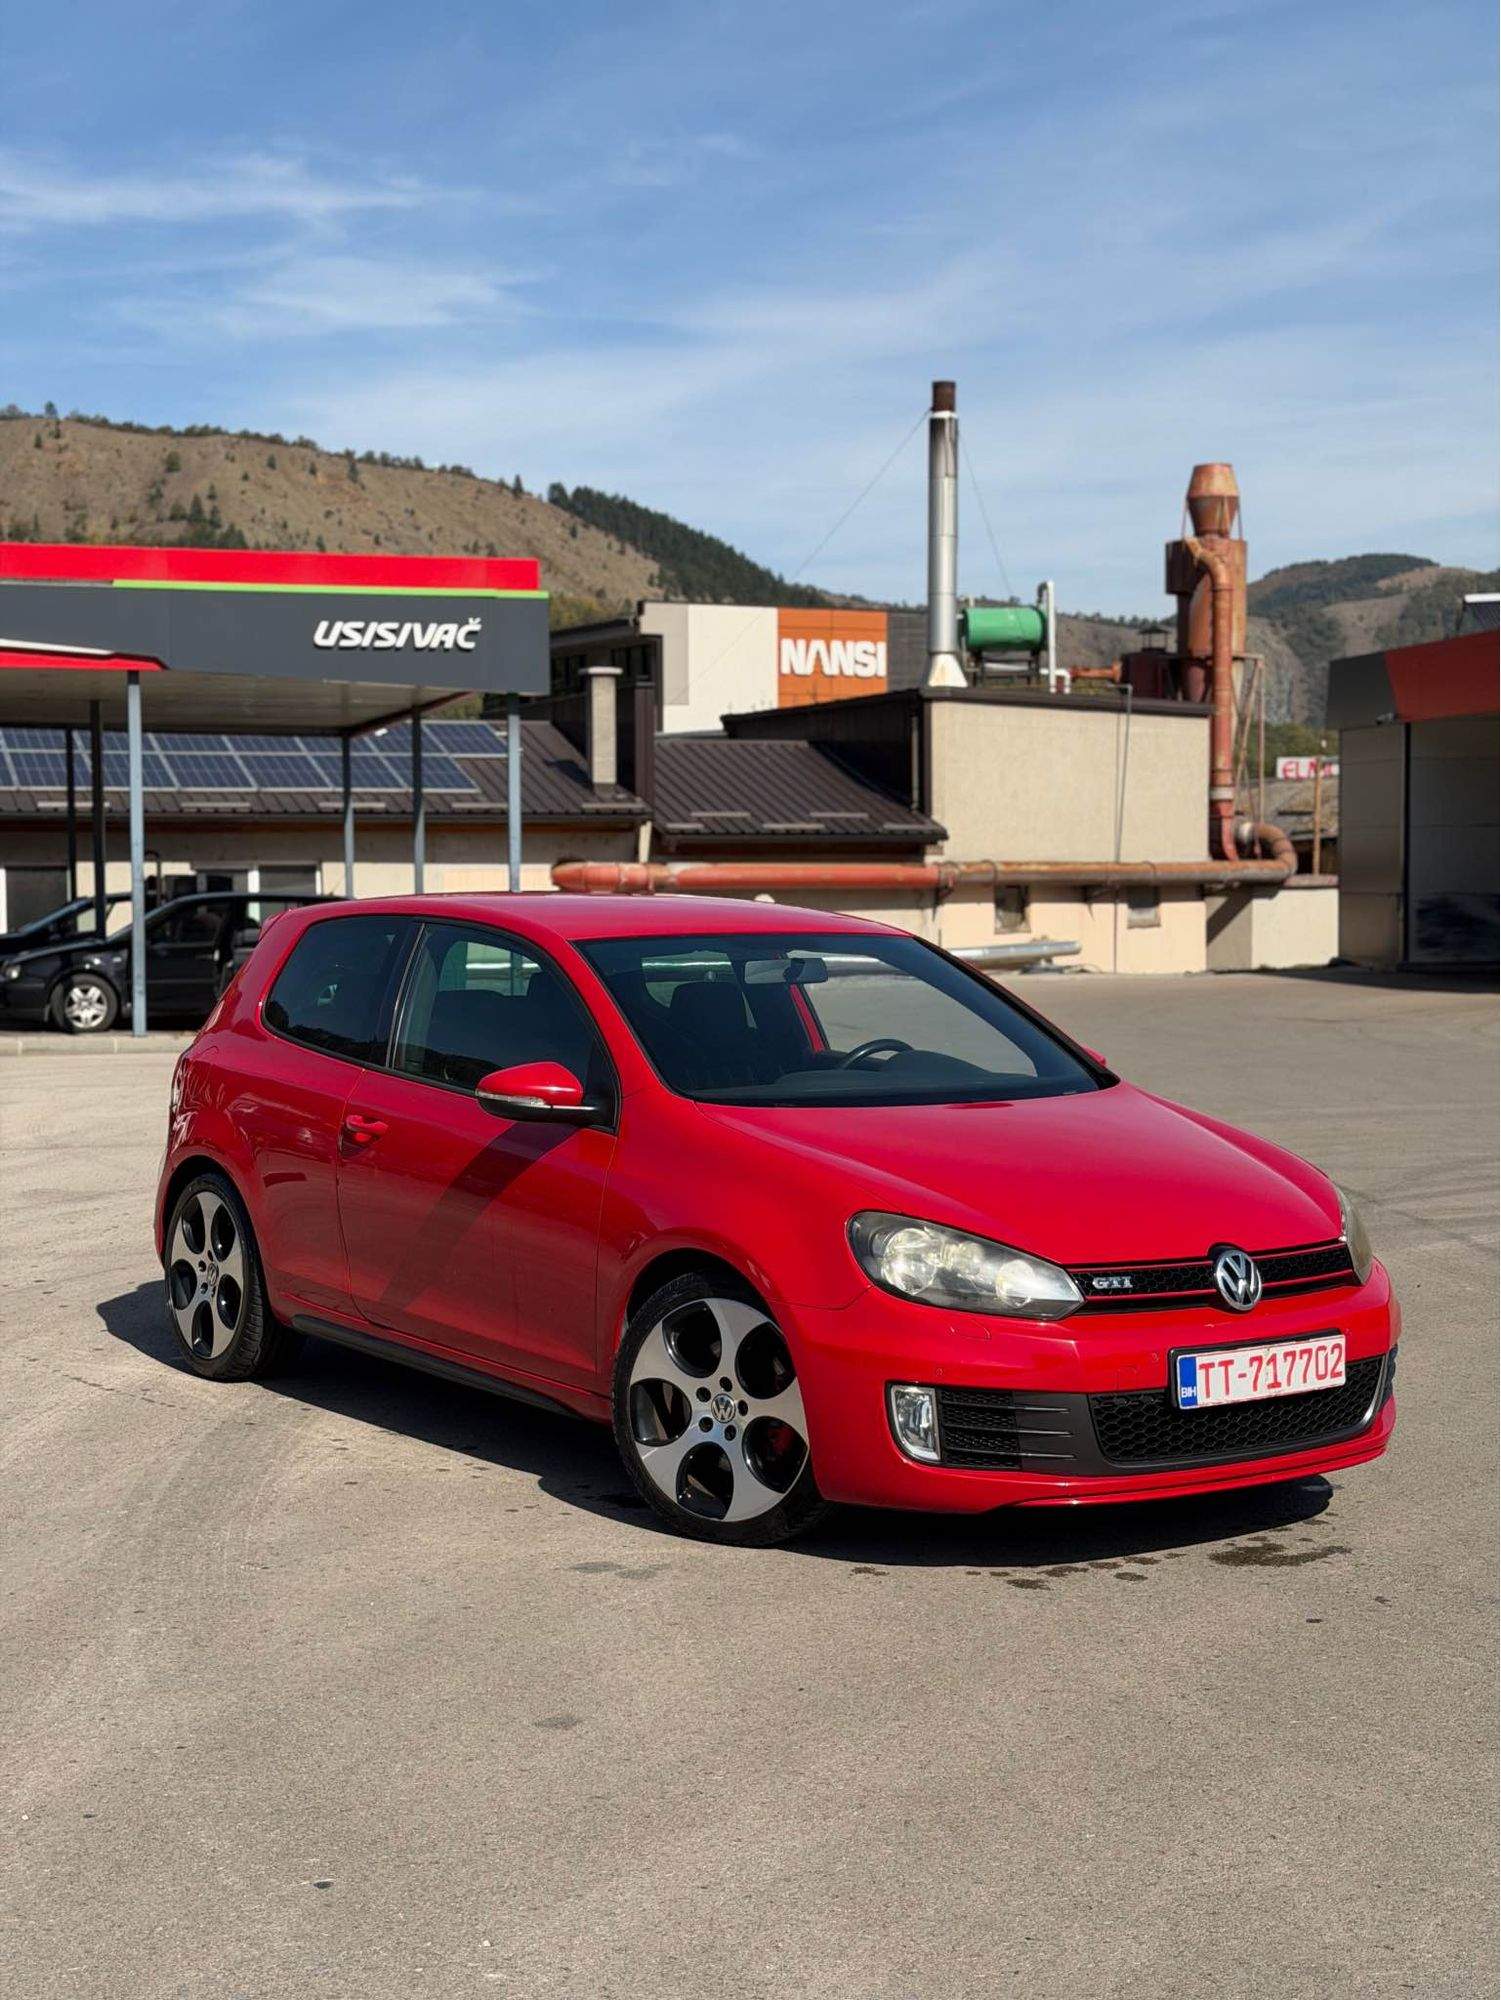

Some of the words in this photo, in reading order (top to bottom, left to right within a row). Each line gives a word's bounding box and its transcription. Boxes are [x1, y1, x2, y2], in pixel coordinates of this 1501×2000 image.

[313, 617, 482, 650] USISIVAČ
[781, 638, 887, 678] NANSI
[1092, 1276, 1133, 1289] GTI
[1199, 1343, 1343, 1398] TT-717702
[1180, 1386, 1197, 1398] BIH
